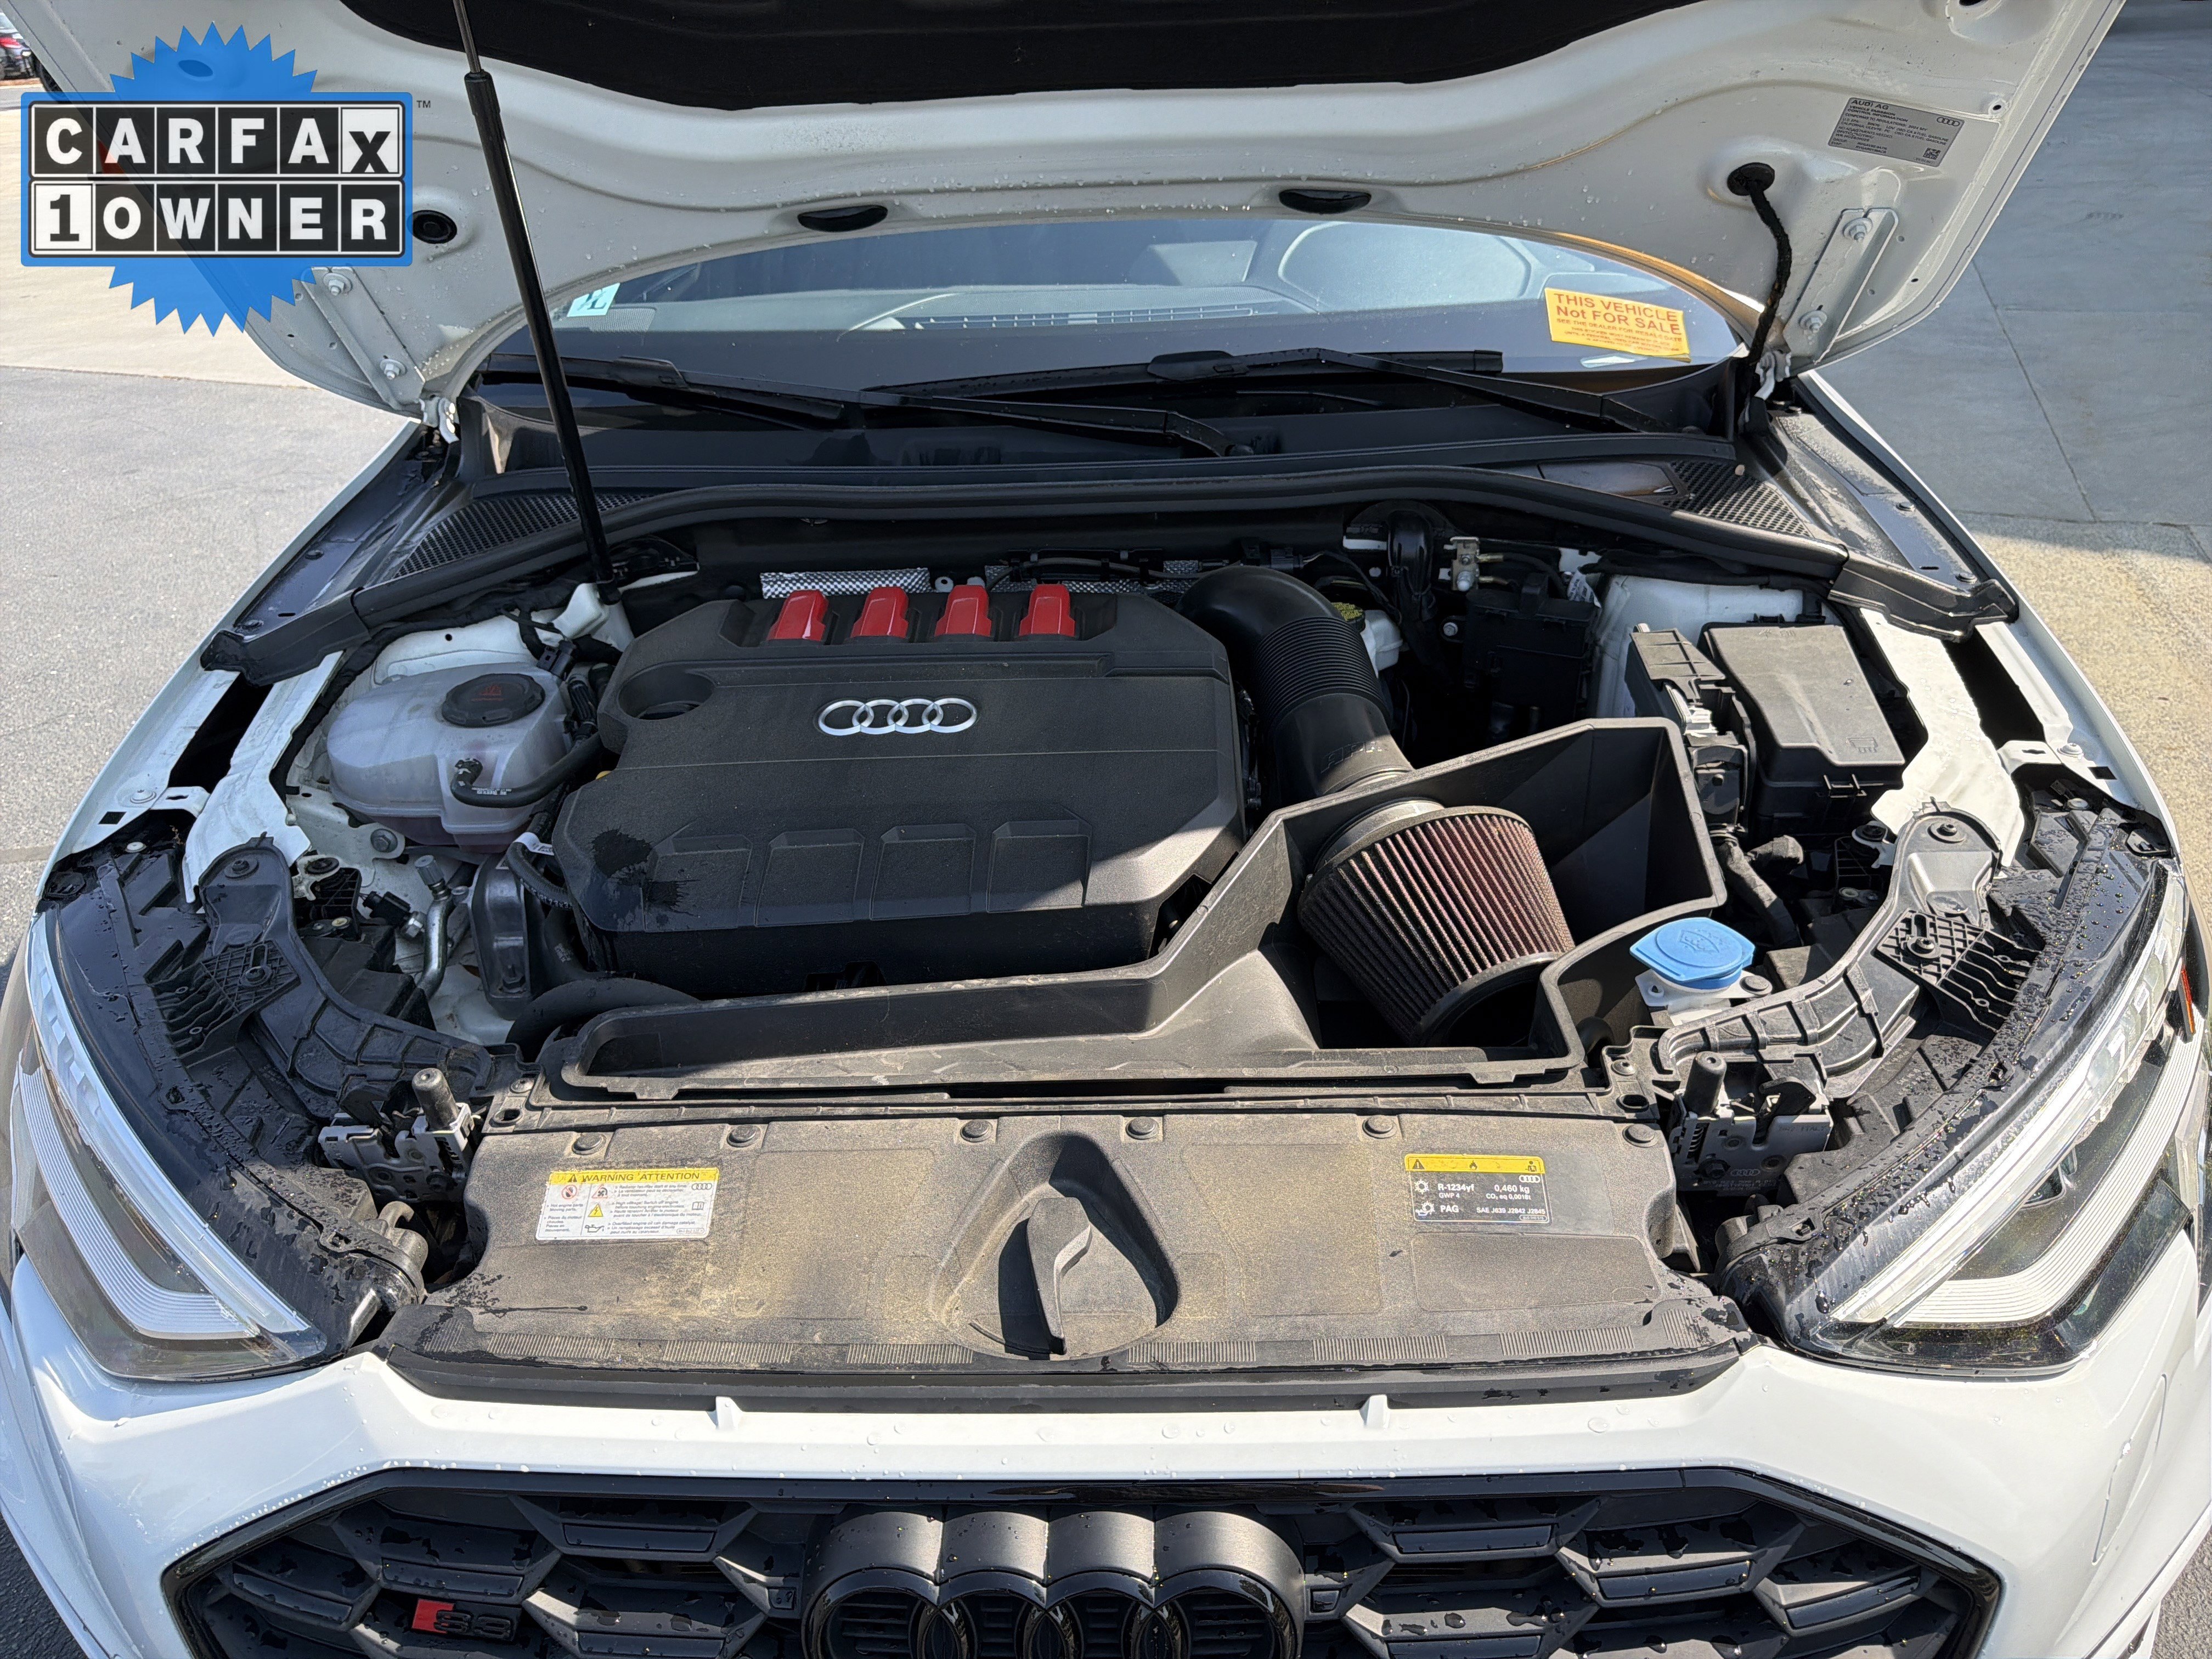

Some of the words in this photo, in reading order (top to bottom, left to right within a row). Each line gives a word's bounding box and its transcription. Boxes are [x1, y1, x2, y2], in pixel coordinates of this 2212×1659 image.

[1872, 112, 1908, 122] INFORMATION
[1554, 294, 1595, 308] THIS
[1600, 300, 1678, 321] VEHICLE
[1556, 306, 1587, 319] Not
[1592, 311, 1629, 325] FOR
[1635, 318, 1681, 335] SALE
[582, 1173, 634, 1182] WARNING
[639, 1172, 700, 1181] ATTENTION
[1437, 1183, 1475, 1193] R-1234yf
[1494, 1184, 1517, 1193] 0,460
[1519, 1185, 1530, 1194] kg
[1440, 1205, 1459, 1213] PAG
